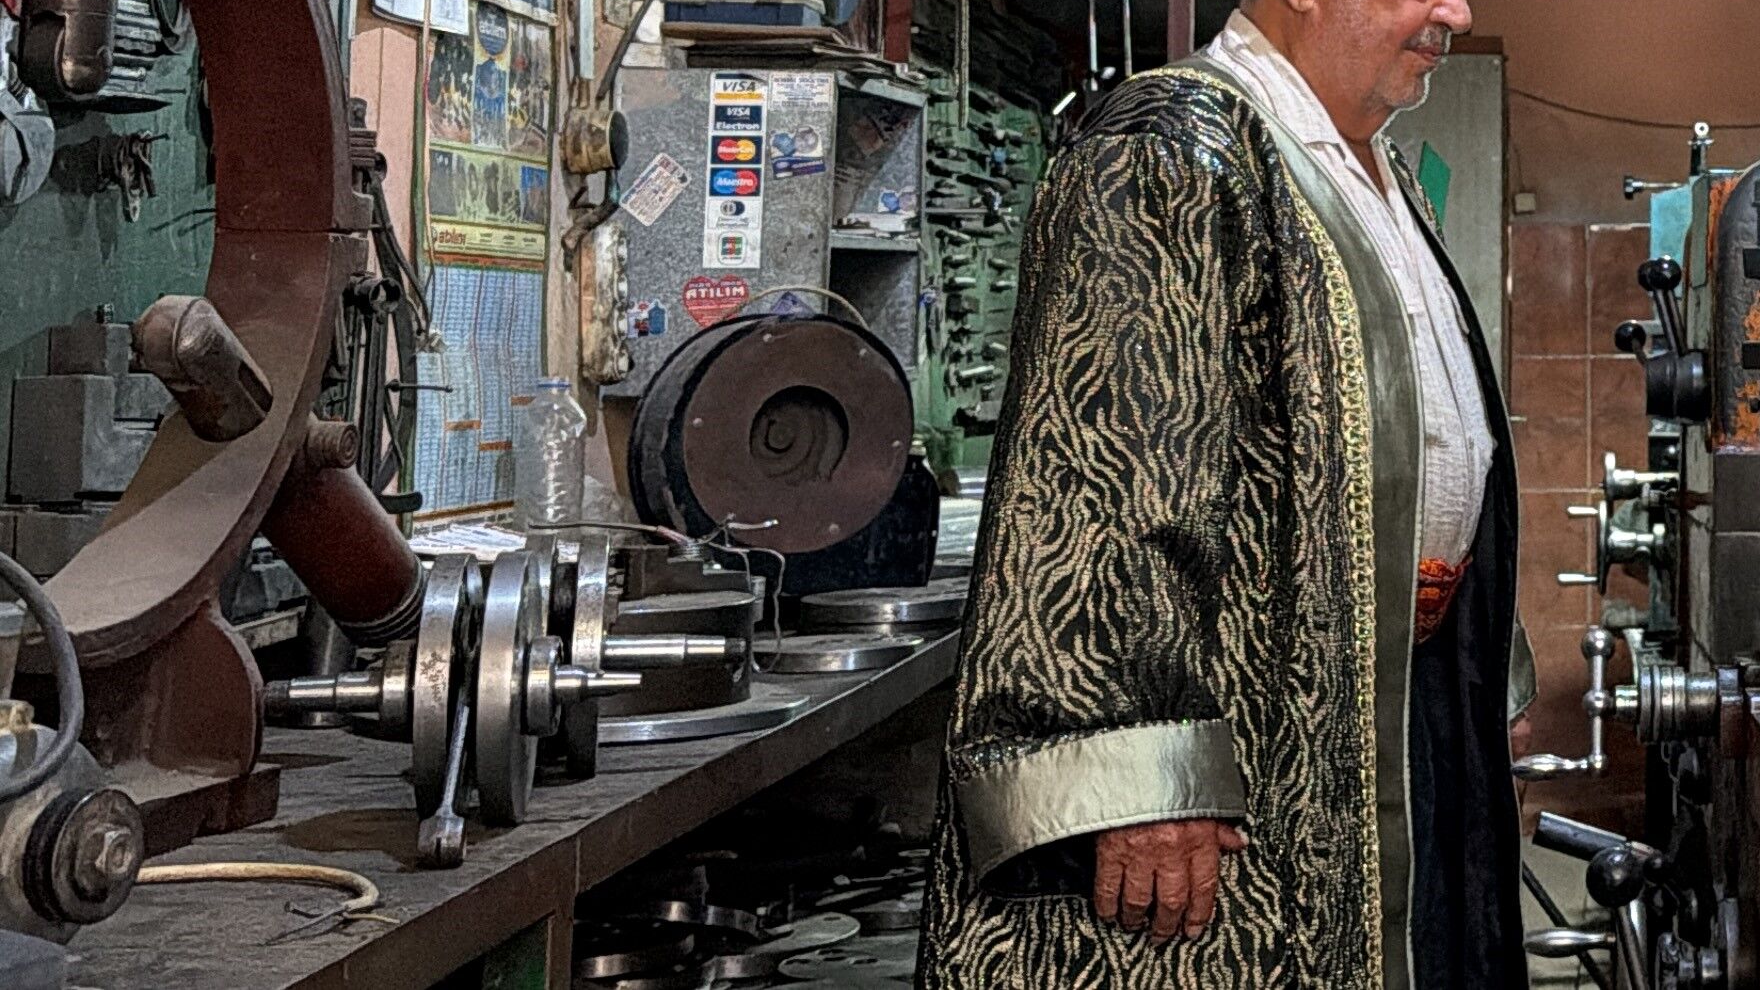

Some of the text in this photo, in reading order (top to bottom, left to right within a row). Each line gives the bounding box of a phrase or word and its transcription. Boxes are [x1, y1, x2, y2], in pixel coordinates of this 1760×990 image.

[722, 81, 756, 92] VISA
[727, 107, 751, 116] VISA
[716, 121, 760, 130] Electron
[716, 177, 754, 187] Maestro
[685, 286, 745, 300] ATILIM
